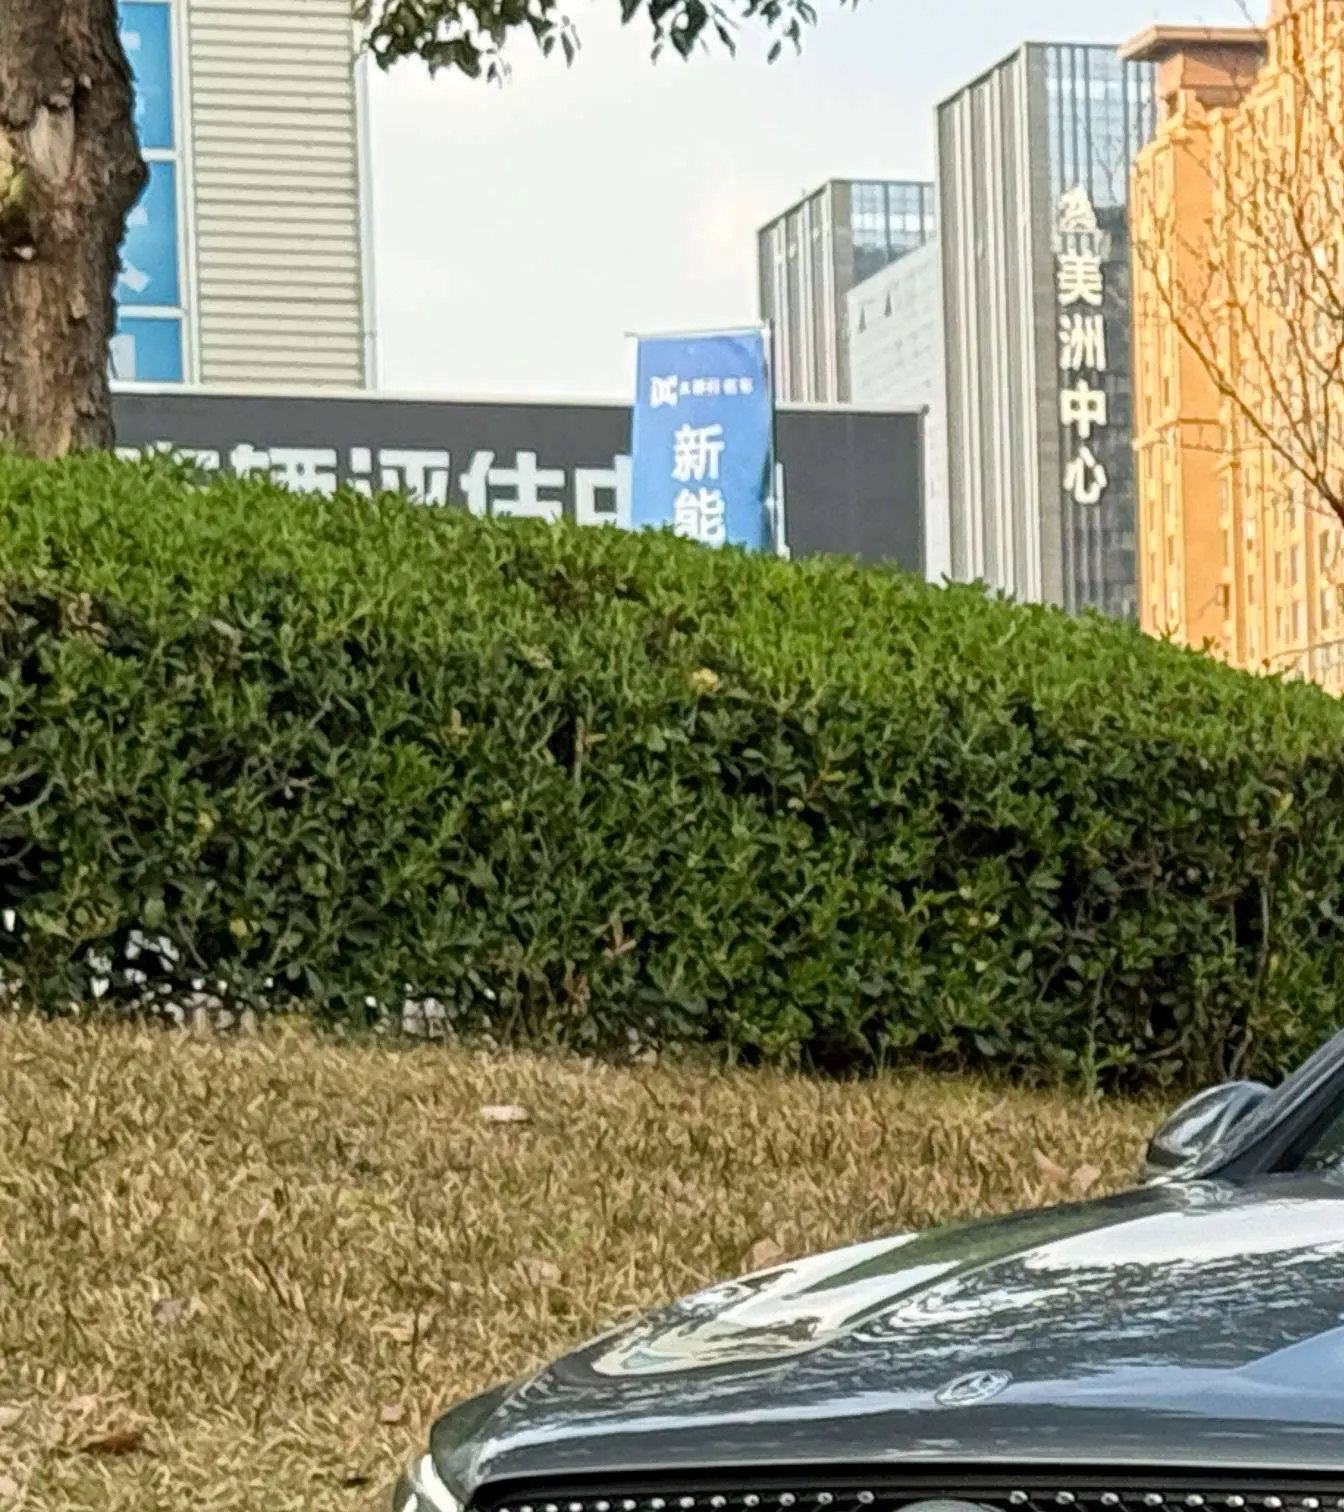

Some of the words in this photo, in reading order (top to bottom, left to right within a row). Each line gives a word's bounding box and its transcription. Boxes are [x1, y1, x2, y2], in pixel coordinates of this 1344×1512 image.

[1056, 252, 1108, 505] 美洲中心
[670, 422, 726, 549] 新能
